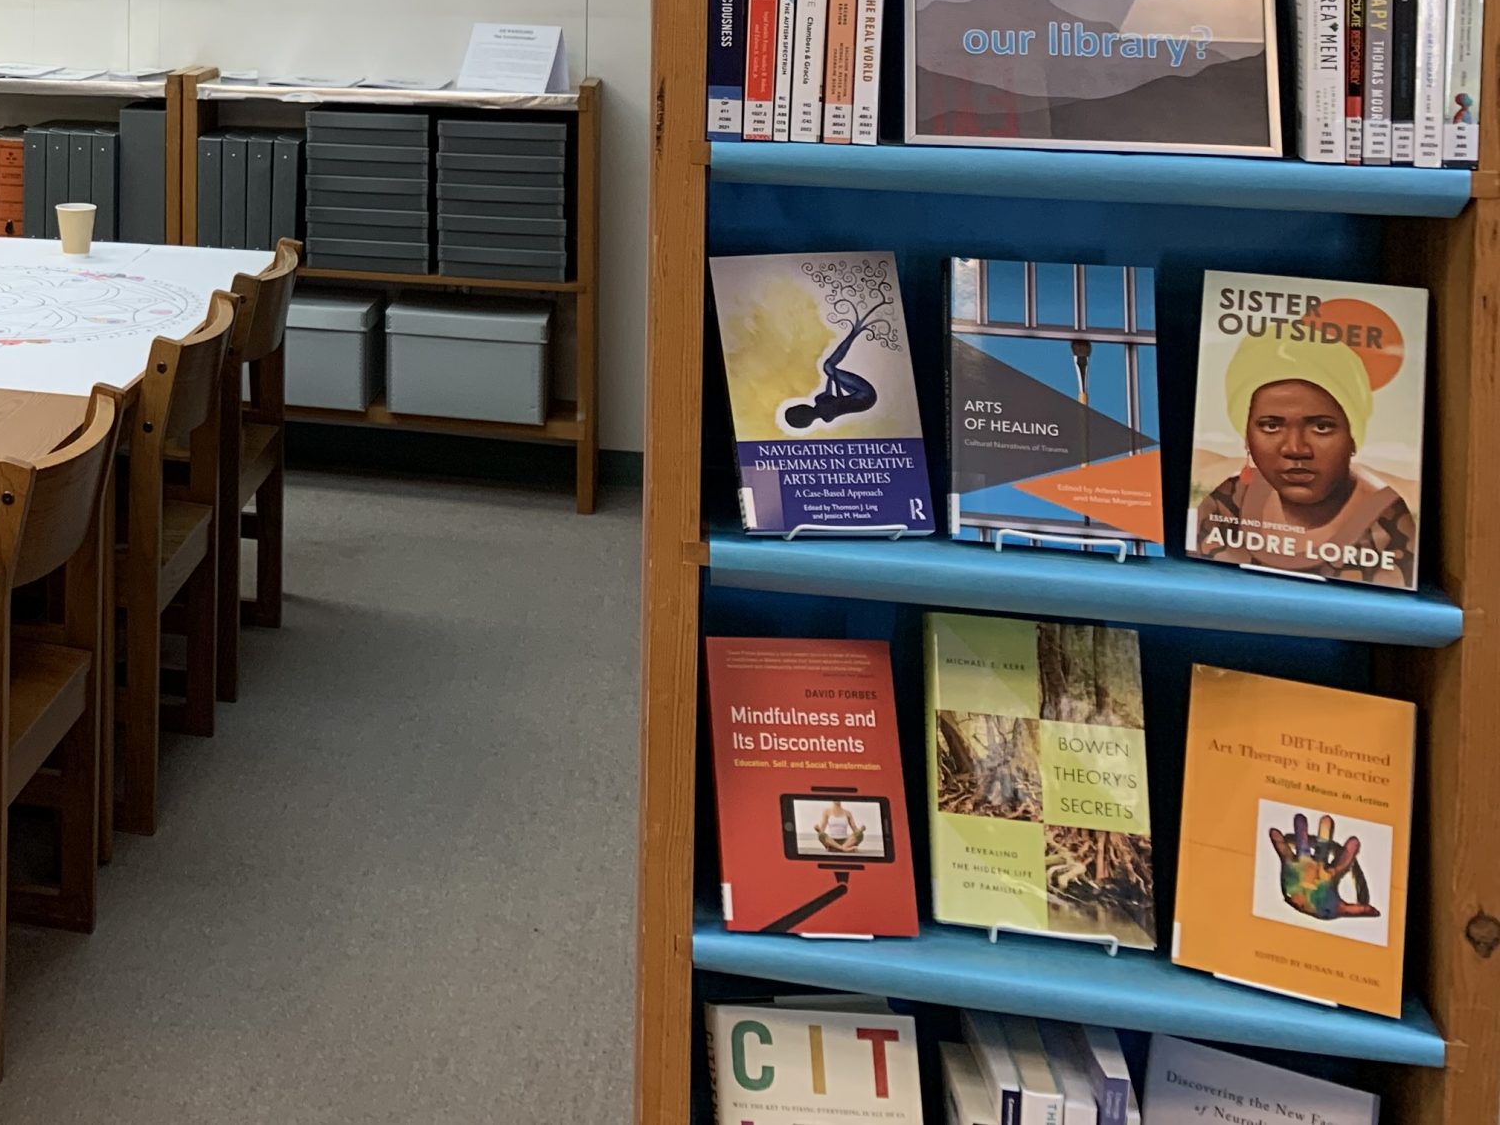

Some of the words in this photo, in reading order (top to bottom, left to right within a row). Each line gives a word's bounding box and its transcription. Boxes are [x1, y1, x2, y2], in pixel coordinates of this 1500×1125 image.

[864, 17, 875, 41] REAL
[963, 27, 1036, 55] our
[1048, 22, 1213, 67] library?
[862, 46, 873, 83] WORLD
[1371, 41, 1385, 84] THOMAS
[1371, 89, 1384, 120] MOOR
[1220, 288, 1322, 318] SISTER
[1218, 313, 1383, 349] OUTSIDER
[964, 400, 1002, 414] ARTS
[964, 417, 986, 431] OF
[991, 420, 1059, 437] HEALING
[759, 444, 844, 457] NAVIGATING
[847, 443, 906, 455] ETHICAL
[755, 458, 827, 471] DILEMMAS
[830, 458, 846, 469] IN
[848, 458, 914, 469] CREATIVE
[783, 474, 815, 485] ARTS
[818, 473, 891, 484] THERAPIES
[795, 490, 801, 498] A
[803, 488, 848, 498] Case-Based
[850, 489, 883, 499] Approach
[1206, 526, 1296, 556] AUDRE
[1306, 541, 1396, 571] LORDE
[805, 690, 835, 699] DAVID
[838, 690, 878, 700] FORBES
[731, 706, 839, 727] Mindfulness
[845, 708, 876, 727] and
[733, 732, 755, 750] Its
[760, 733, 865, 753] Discontents
[1058, 737, 1130, 758] BOWEN
[1281, 733, 1391, 767] DBT-Informed
[1208, 739, 1233, 755] Art
[1238, 744, 1300, 771] Therapy
[1306, 759, 1321, 772] in
[1326, 762, 1391, 786] Practice
[1053, 766, 1138, 789] THEORY'S
[1060, 797, 1134, 820] SECRETS
[1166, 1070, 1244, 1106] Discovering
[1249, 1097, 1271, 1112] the
[1276, 1103, 1306, 1121] New
